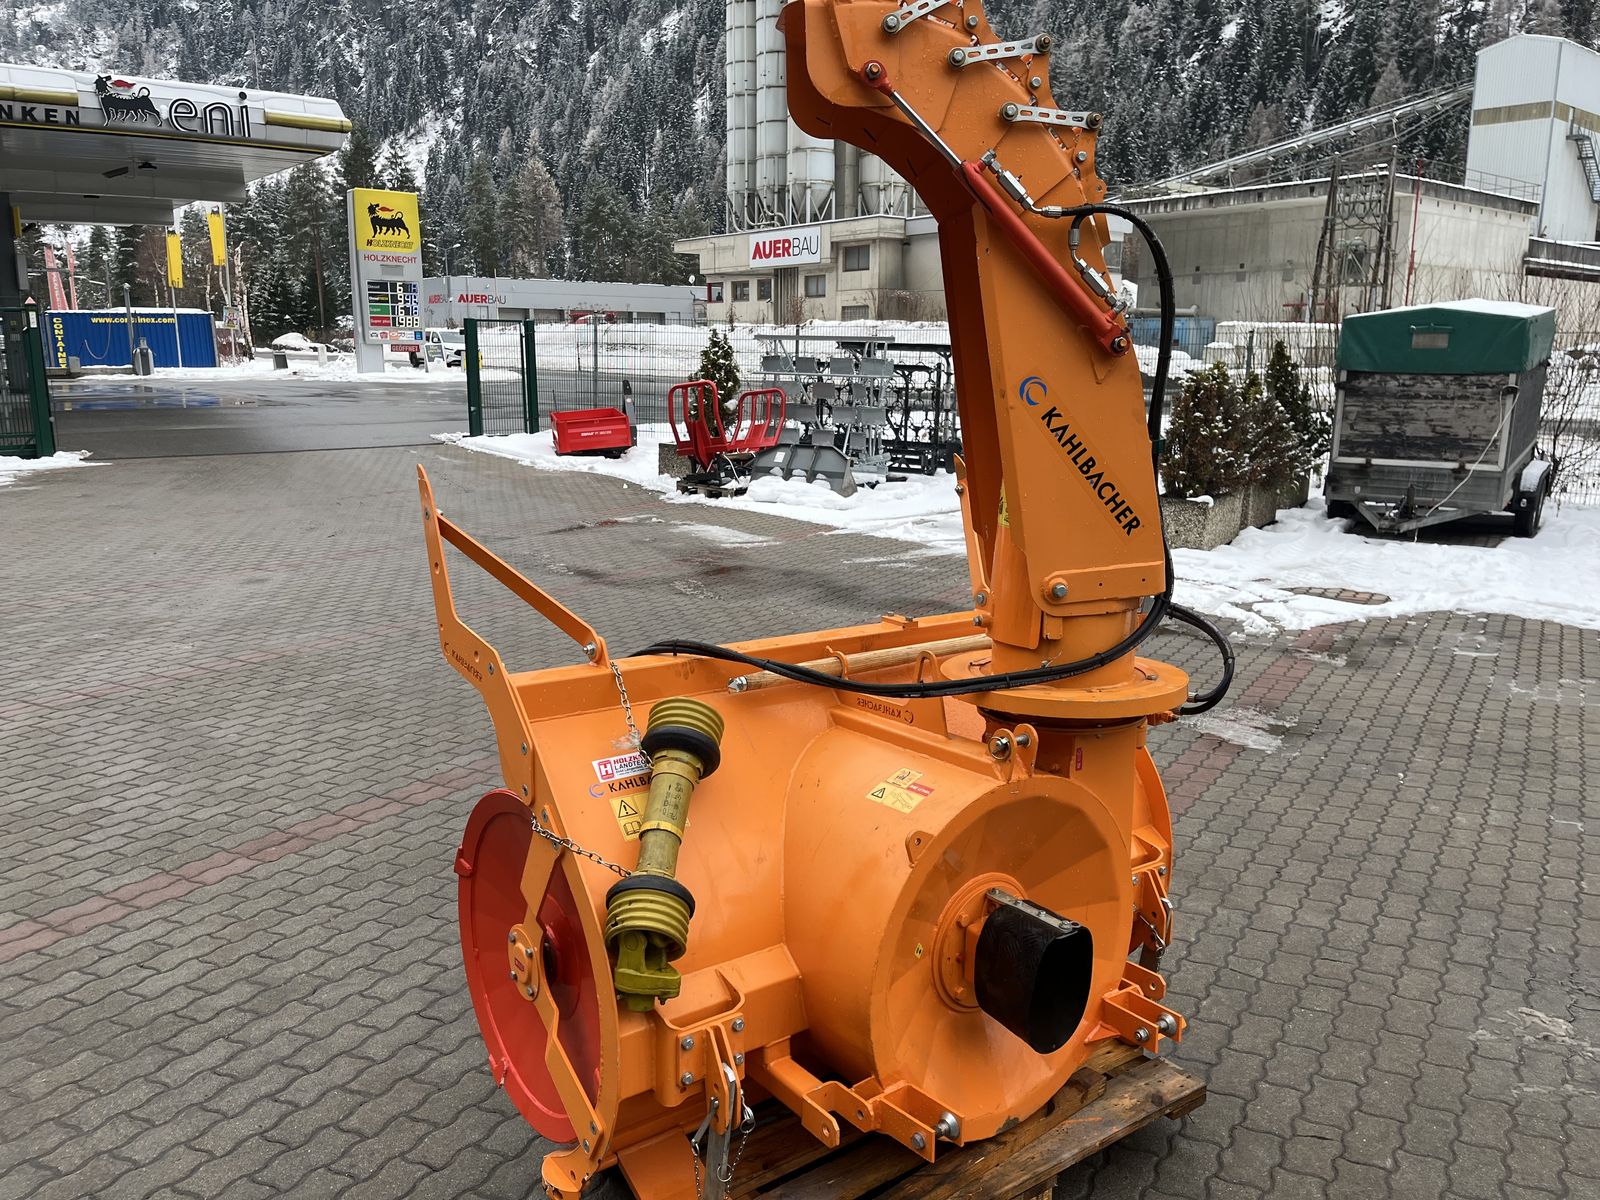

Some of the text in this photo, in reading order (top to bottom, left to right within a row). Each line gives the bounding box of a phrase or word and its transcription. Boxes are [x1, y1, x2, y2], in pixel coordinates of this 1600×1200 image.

[168, 91, 251, 138] eni
[363, 254, 418, 264] HOLZKNECHT
[751, 235, 819, 260] AUERBAU
[457, 293, 507, 305] AUERBAU
[1041, 406, 1141, 536] KAHLBACHER
